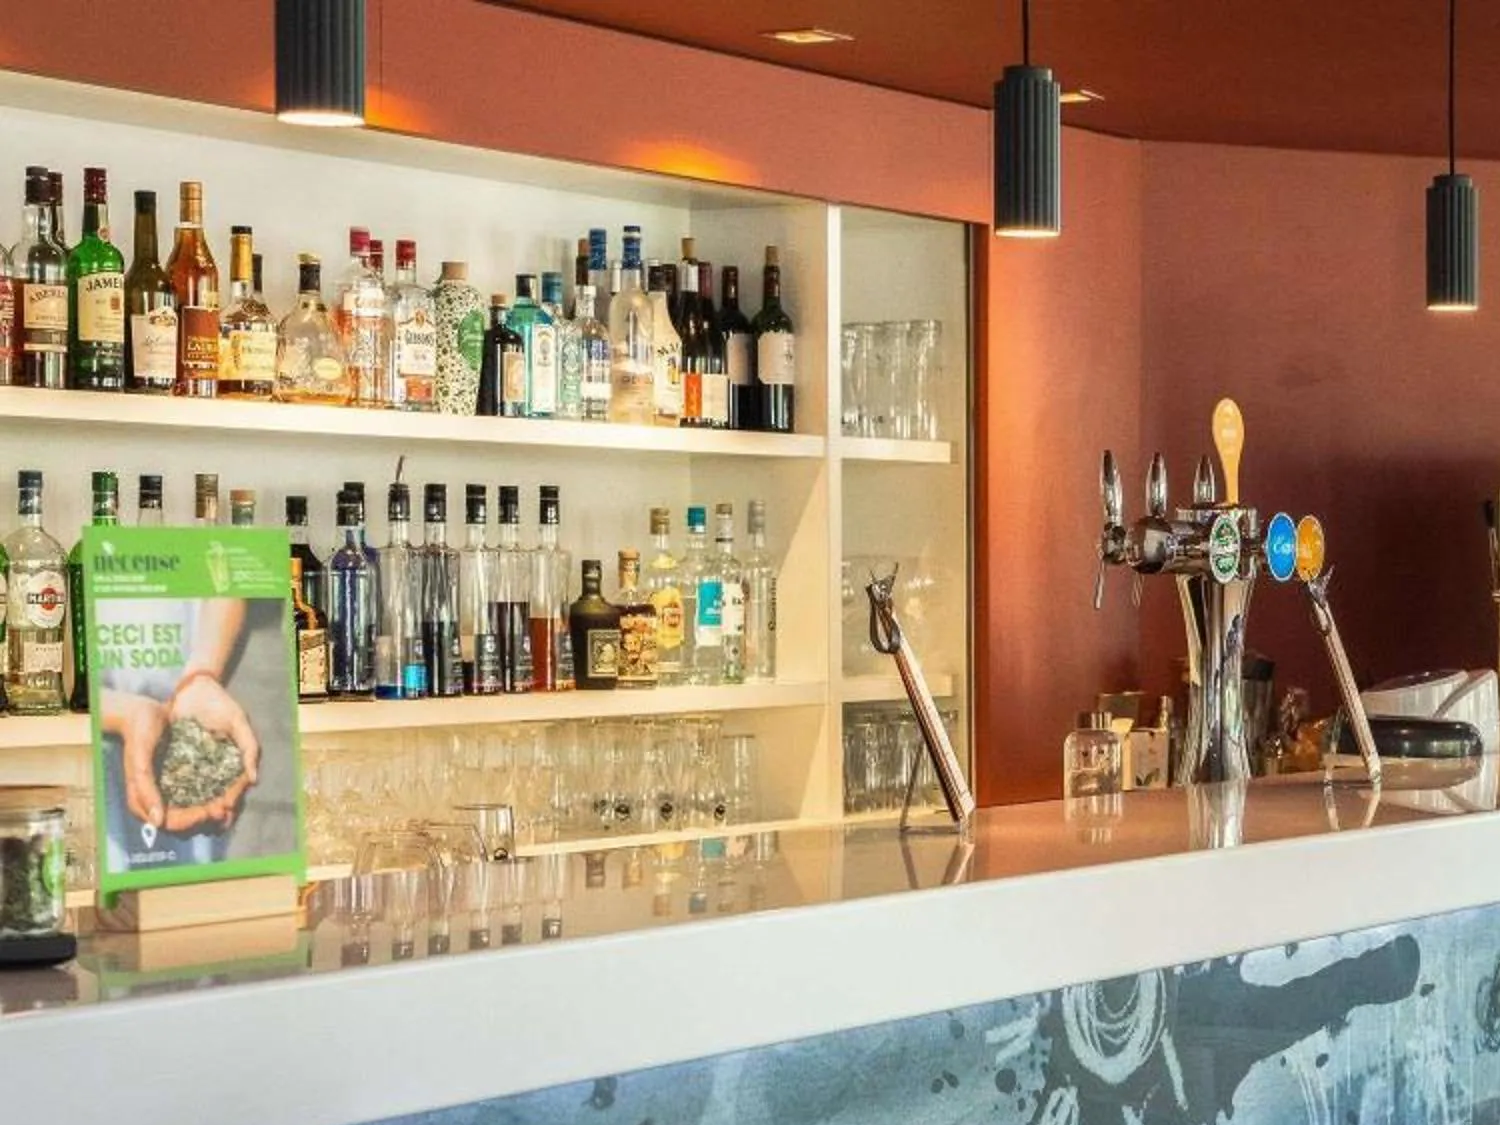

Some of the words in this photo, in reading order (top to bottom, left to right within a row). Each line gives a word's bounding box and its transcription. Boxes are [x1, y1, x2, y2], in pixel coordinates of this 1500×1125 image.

[86, 277, 123, 293] JAME
[98, 624, 145, 646] CECI
[152, 623, 182, 645] EST
[129, 647, 184, 669] SODA
